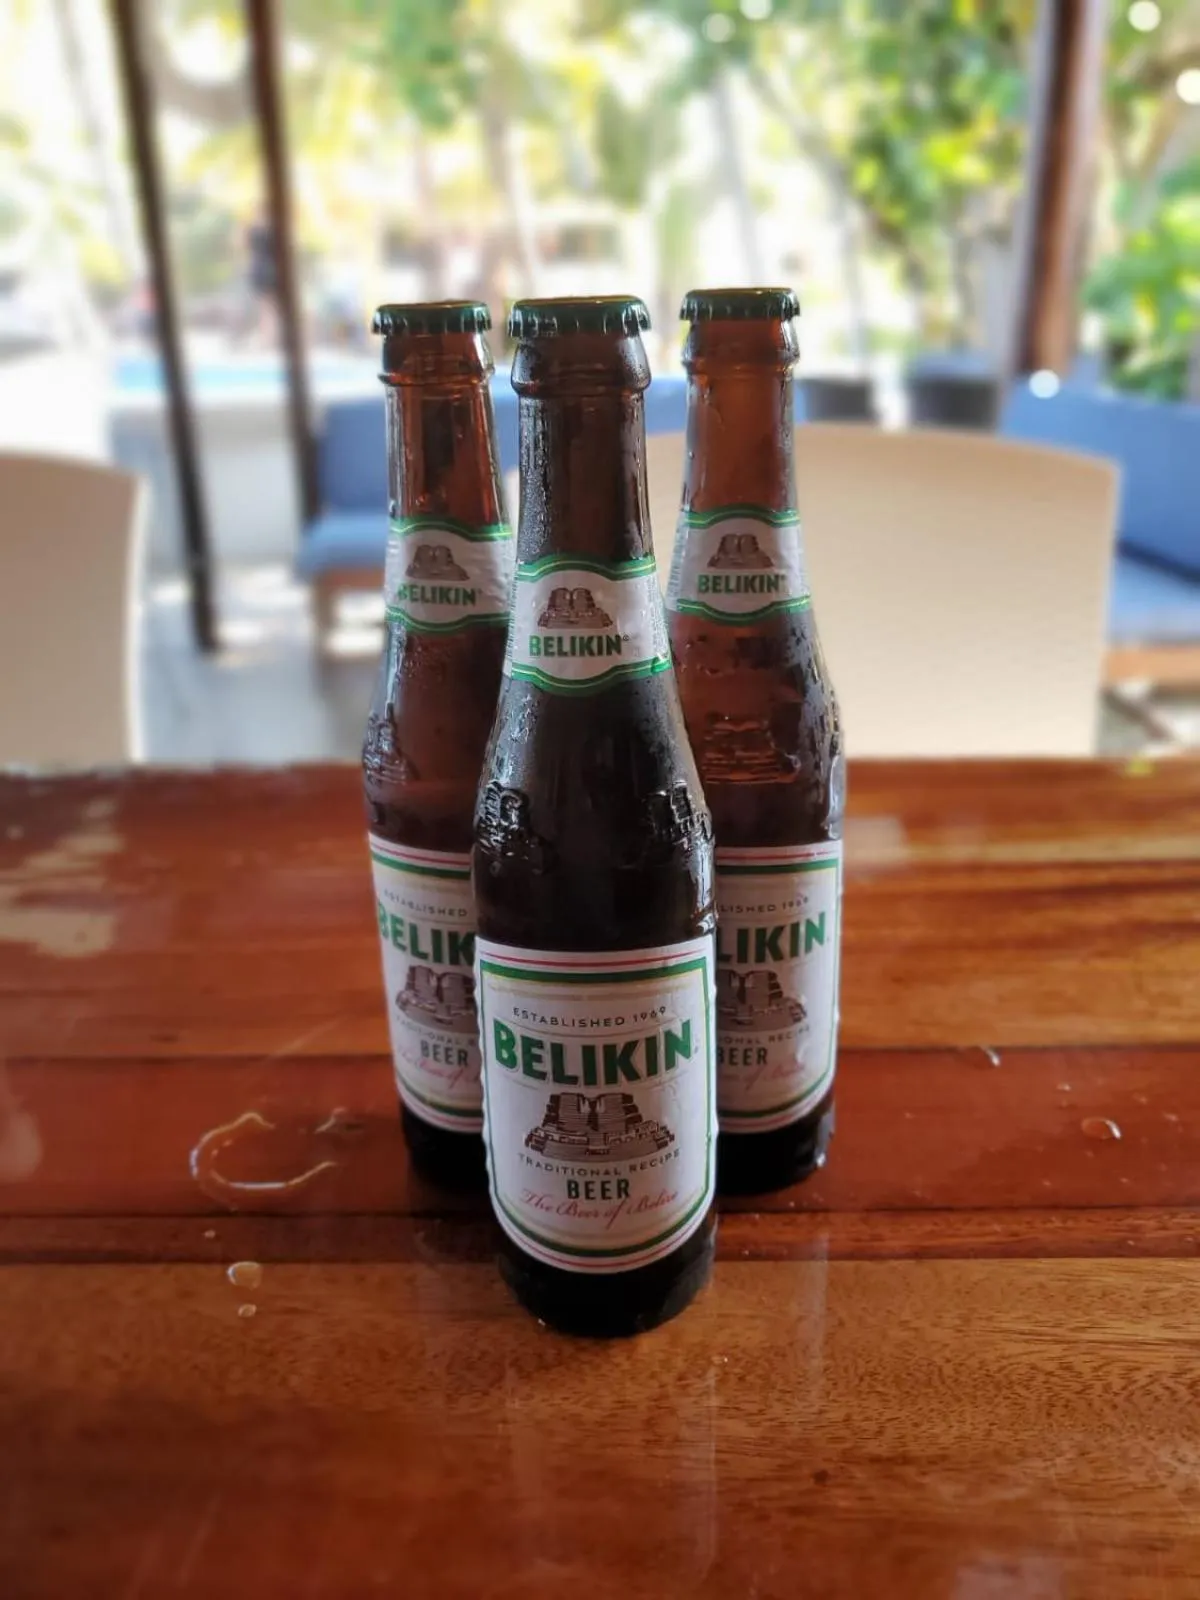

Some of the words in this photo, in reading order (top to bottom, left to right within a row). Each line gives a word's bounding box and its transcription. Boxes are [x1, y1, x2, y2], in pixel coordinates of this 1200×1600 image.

[398, 584, 476, 606] BELIKIN
[697, 574, 780, 593] BELIKIN
[529, 635, 622, 657] BELIKIN
[718, 903, 776, 914] LISHED
[378, 900, 475, 966] BELIK
[716, 912, 825, 964] LIKIN
[513, 1007, 625, 1028] ESTABLISHED
[633, 1006, 667, 1023] 1969
[420, 1039, 469, 1068] BEER
[493, 1018, 692, 1086] BELIKIN
[518, 1153, 622, 1176] TRADITIONAL
[629, 1149, 681, 1173] RECIPE
[567, 1179, 630, 1200] BEER
[522, 1188, 553, 1212] The
[556, 1200, 599, 1219] Beer
[603, 1200, 626, 1231] of
